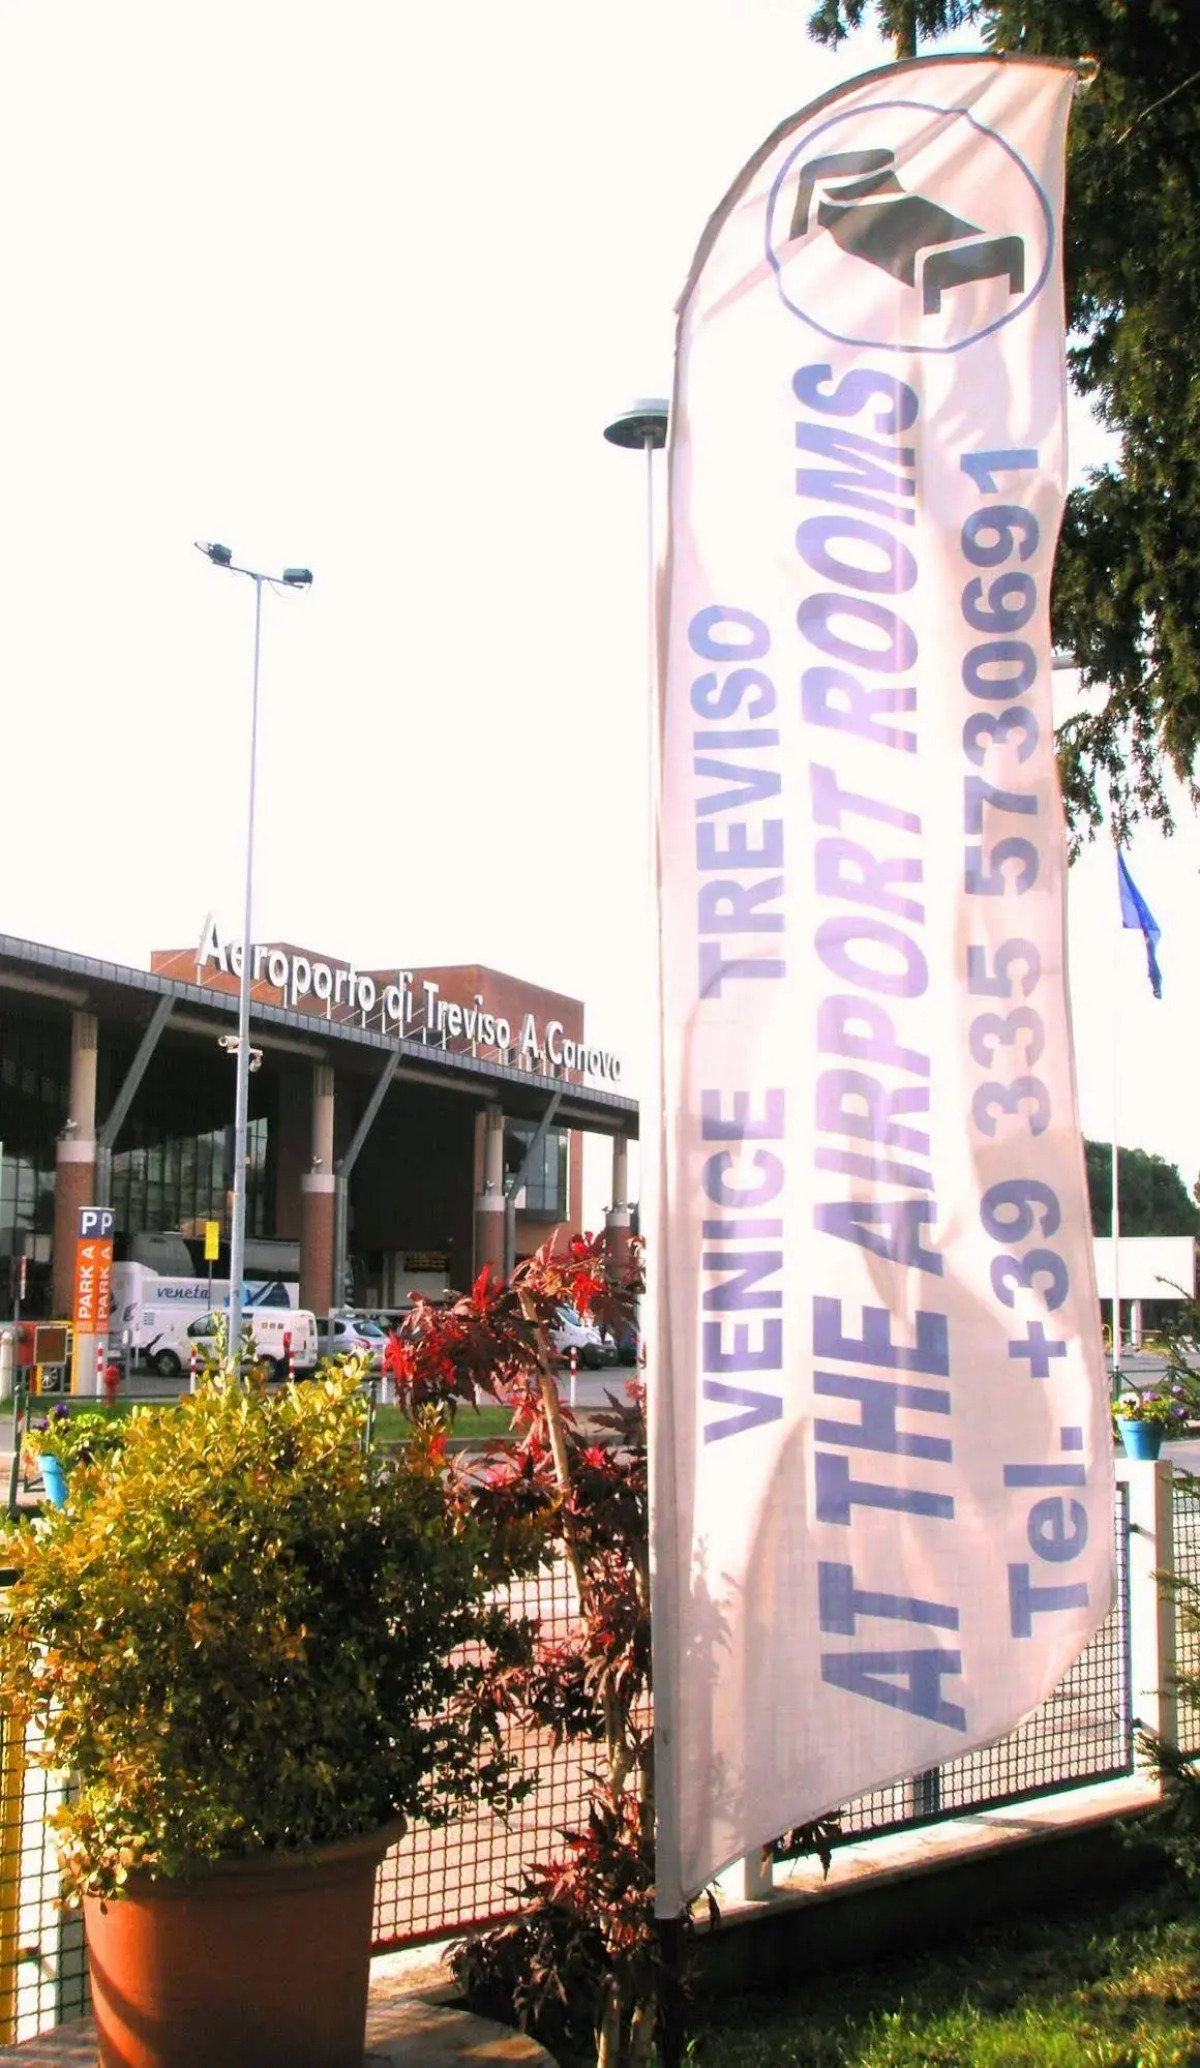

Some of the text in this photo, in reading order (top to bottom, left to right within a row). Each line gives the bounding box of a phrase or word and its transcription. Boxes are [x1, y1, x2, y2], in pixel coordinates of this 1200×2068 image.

[196, 911, 376, 1012] Aeroporto
[385, 971, 413, 1022] di
[423, 980, 510, 1049] Treviso
[688, 605, 786, 1446] VENICE TREVISO
[791, 363, 967, 1733] AT THE AIRPORT ROOMS
[959, 448, 1090, 1639] Tel. +39 335 5730691
[81, 1245, 96, 1260] A
[82, 1211, 98, 1235] P
[101, 1212, 113, 1235] P
[78, 1265, 96, 1319] PARK
[97, 1245, 112, 1319] PARK A
